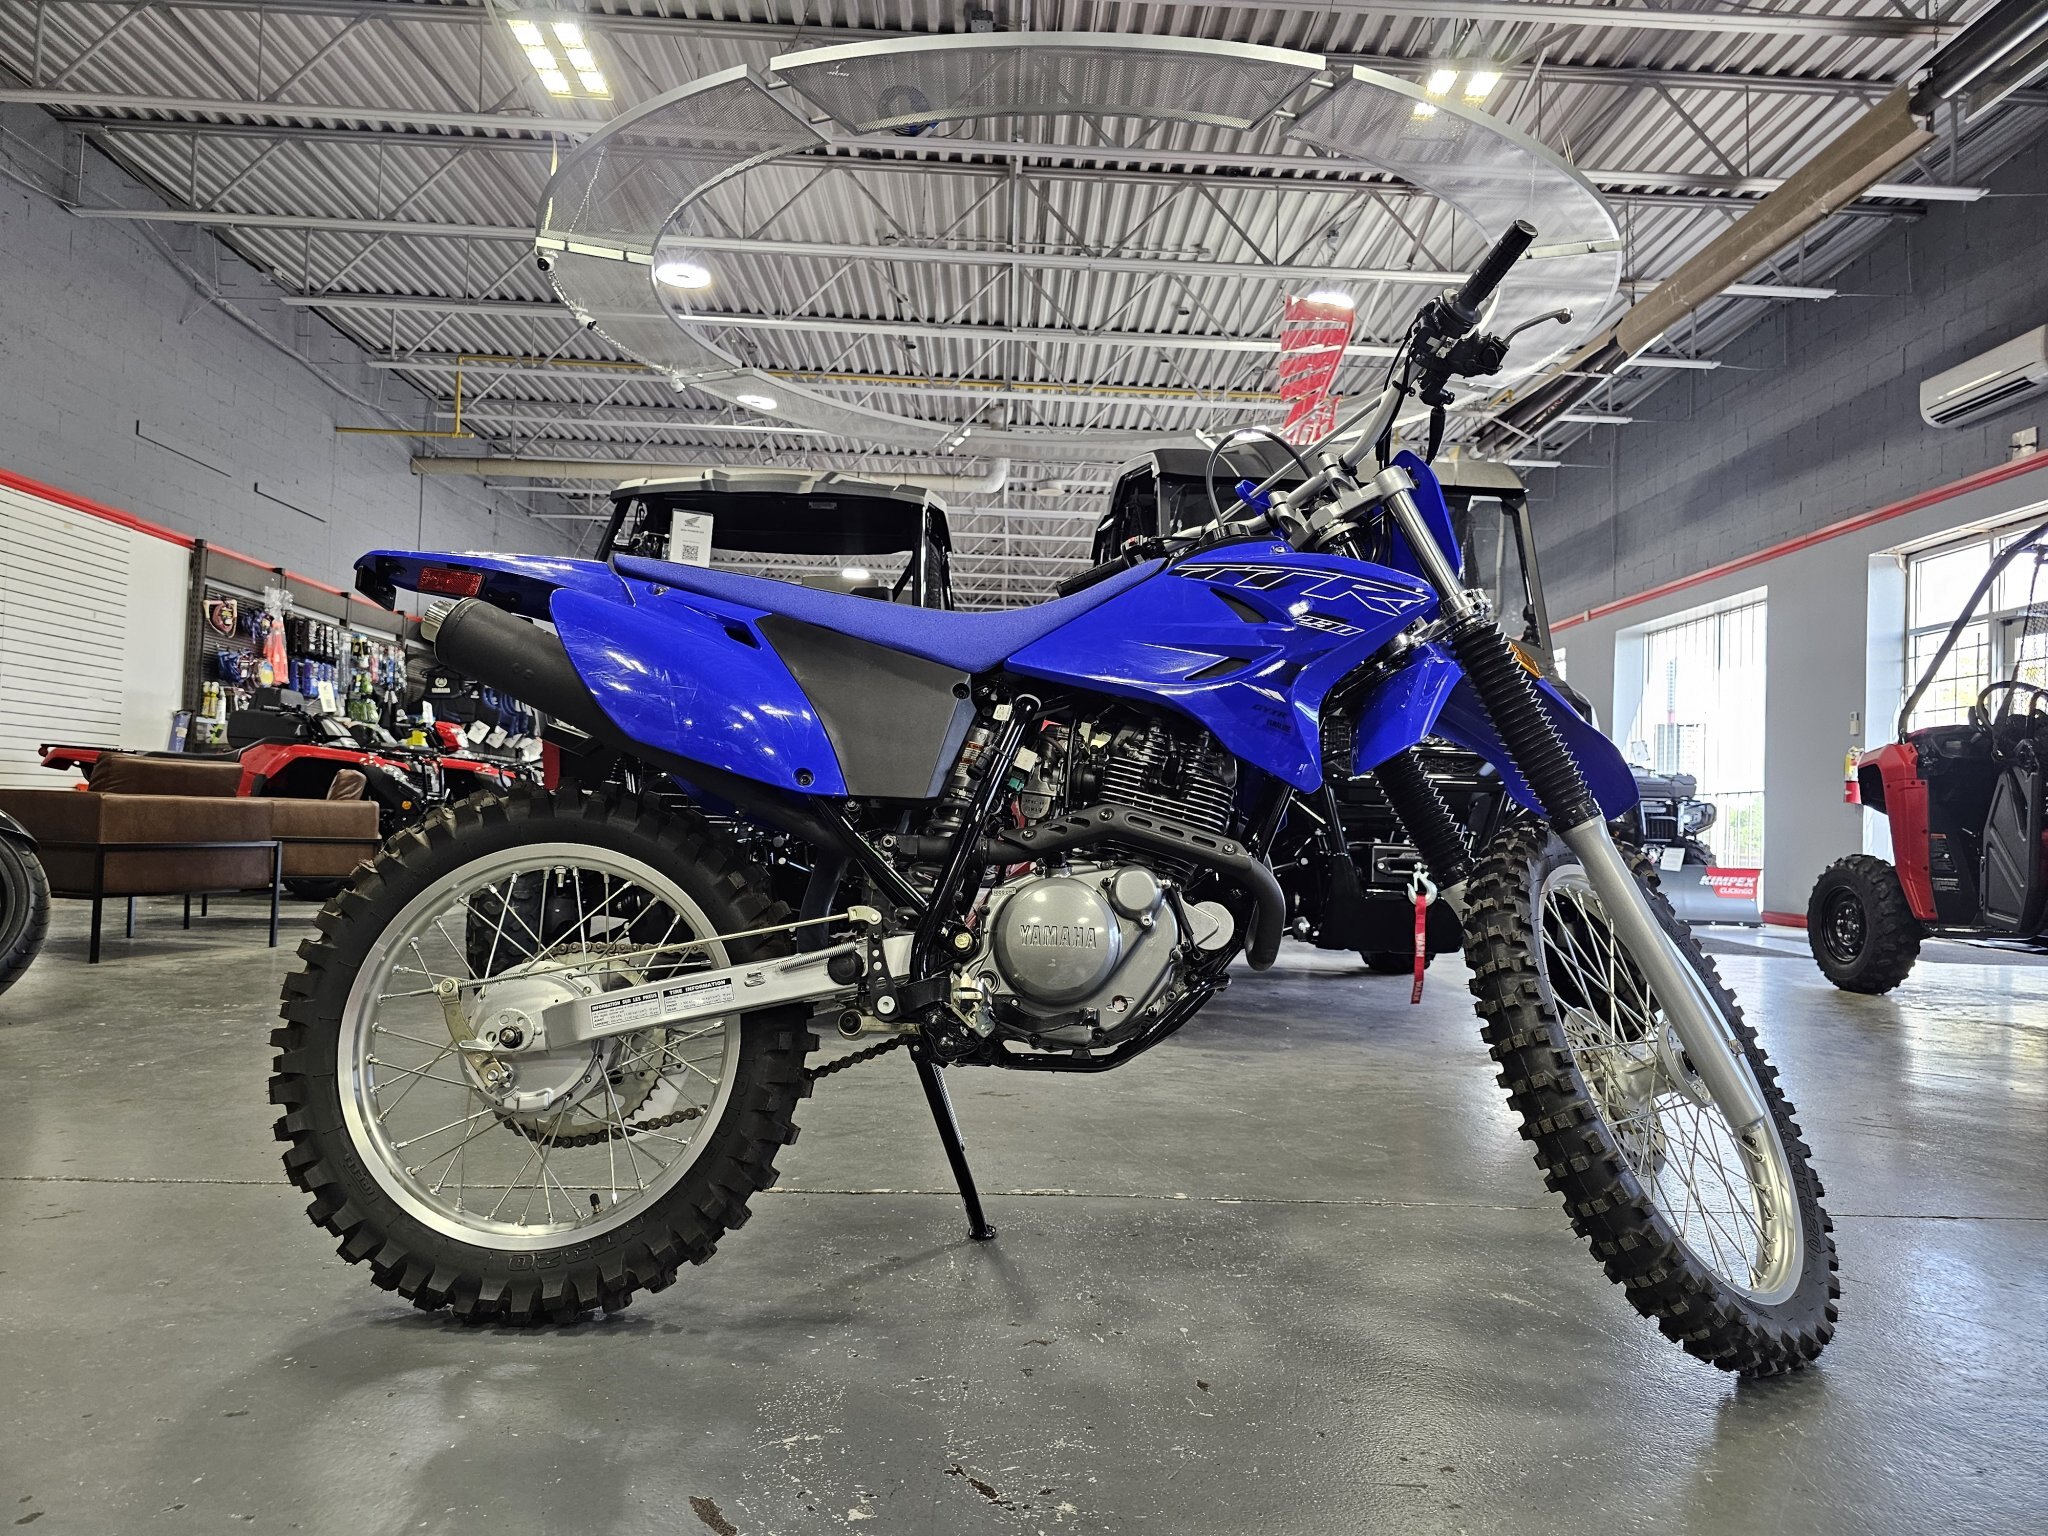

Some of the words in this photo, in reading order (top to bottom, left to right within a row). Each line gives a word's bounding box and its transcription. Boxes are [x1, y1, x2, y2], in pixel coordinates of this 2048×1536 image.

[1699, 875, 1756, 887] KIMPEX
[1020, 924, 1097, 949] YAMAHA
[1415, 932, 1426, 957] WARN
[685, 980, 726, 993] INFORMATION
[591, 1000, 621, 1012] INFORMATION
[642, 992, 658, 1000] PNEUS
[506, 1212, 649, 1272] MT320
